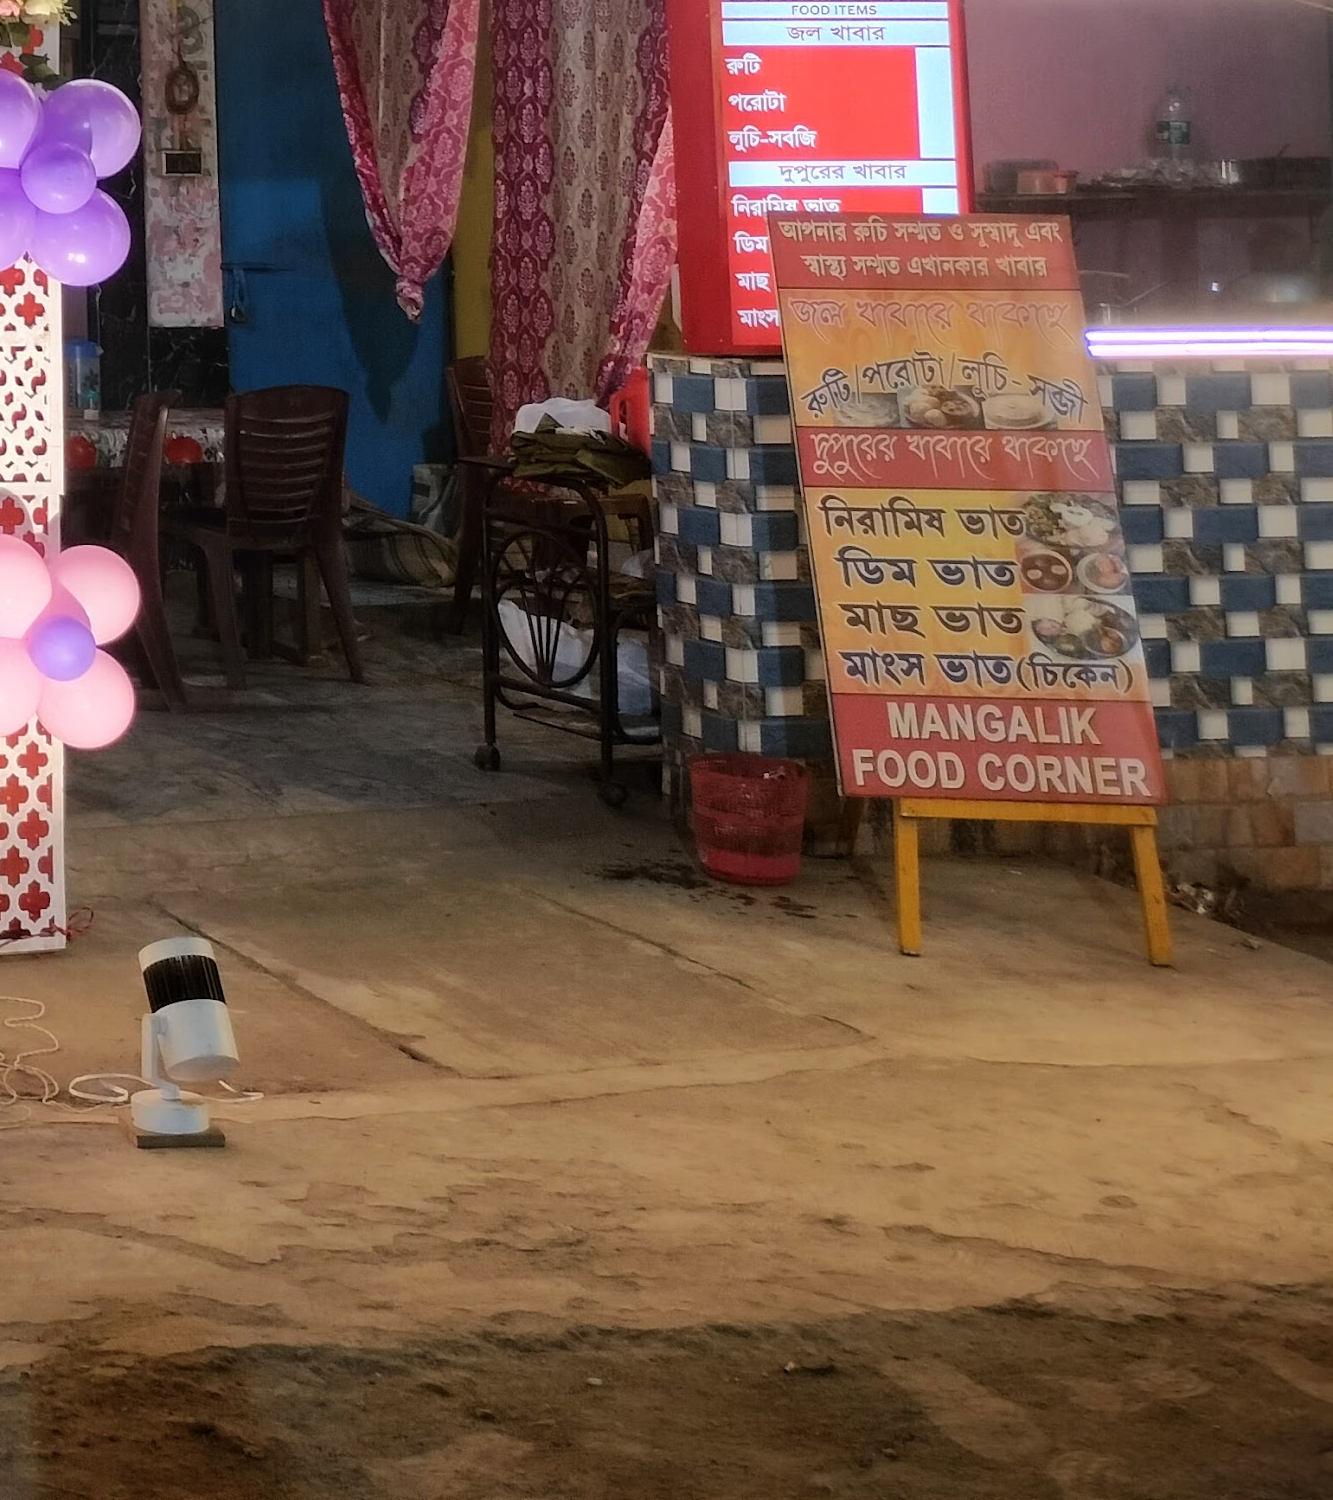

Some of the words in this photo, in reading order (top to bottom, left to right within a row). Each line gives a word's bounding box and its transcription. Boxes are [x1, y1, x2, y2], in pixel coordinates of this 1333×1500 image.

[791, 4, 831, 16] FOOD
[834, 4, 877, 16] ITEMS
[785, 25, 822, 41] জল
[830, 25, 885, 41] খাবার
[725, 52, 762, 75] রুটি
[728, 90, 786, 112] পরোটা
[779, 164, 845, 185] দুপুরের
[853, 164, 907, 181] খাবার
[777, 219, 847, 243] আপনার
[851, 216, 888, 243] রুচি
[948, 223, 964, 241] ও
[1025, 222, 1064, 243] এবং
[733, 232, 768, 254] ডিম
[908, 255, 989, 277] এখানকার
[995, 255, 1048, 277] খাবার
[736, 271, 771, 292] মাছ
[817, 495, 945, 538] নিরামিষ
[957, 505, 1027, 539] ভাত
[833, 545, 918, 588] ডিম
[928, 555, 1019, 589] ভাত
[840, 599, 925, 639] মাছ
[934, 601, 1025, 638] ভাত
[840, 648, 924, 686] মাংস
[887, 701, 1102, 746] MANGALIK
[852, 749, 966, 790] FOOD
[977, 751, 1153, 798] CORNER
